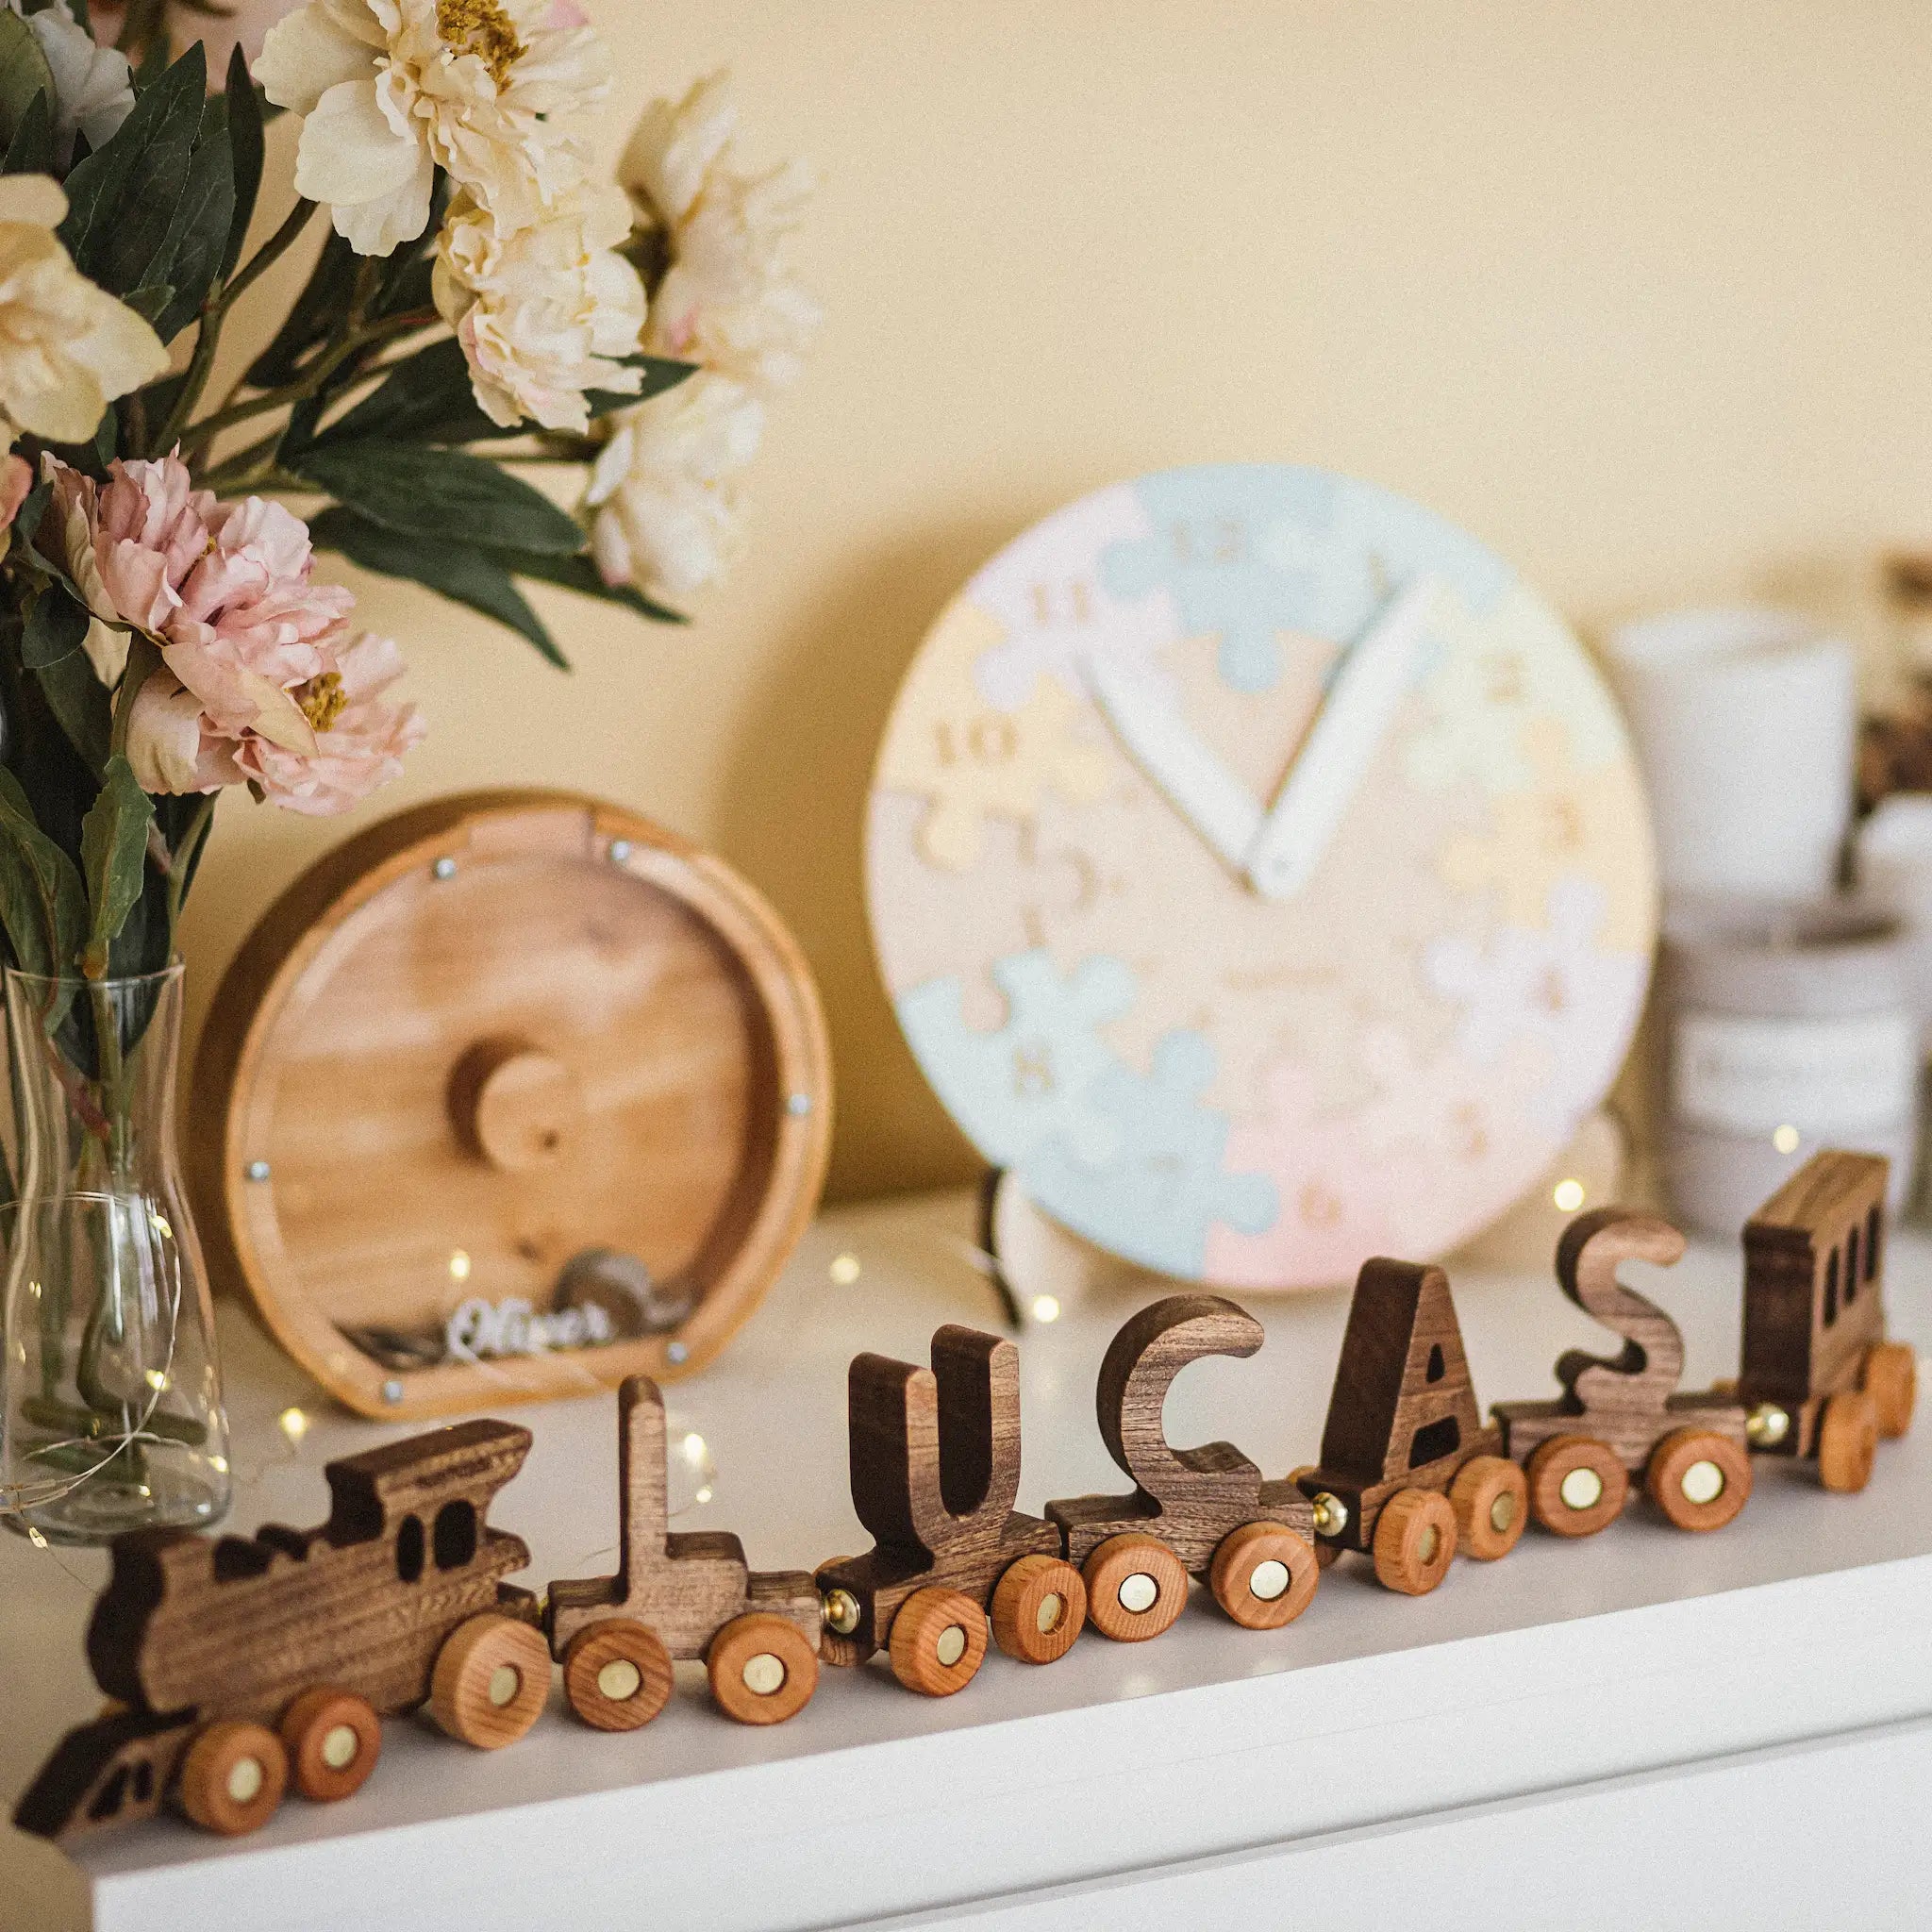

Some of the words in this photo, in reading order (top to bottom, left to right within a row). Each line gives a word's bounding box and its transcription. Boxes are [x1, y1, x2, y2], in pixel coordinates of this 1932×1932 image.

[1170, 519, 1247, 561] 12
[1031, 577, 1092, 627] 11
[932, 715, 1020, 768] 10
[616, 1206, 1687, 1623] LUCAS
